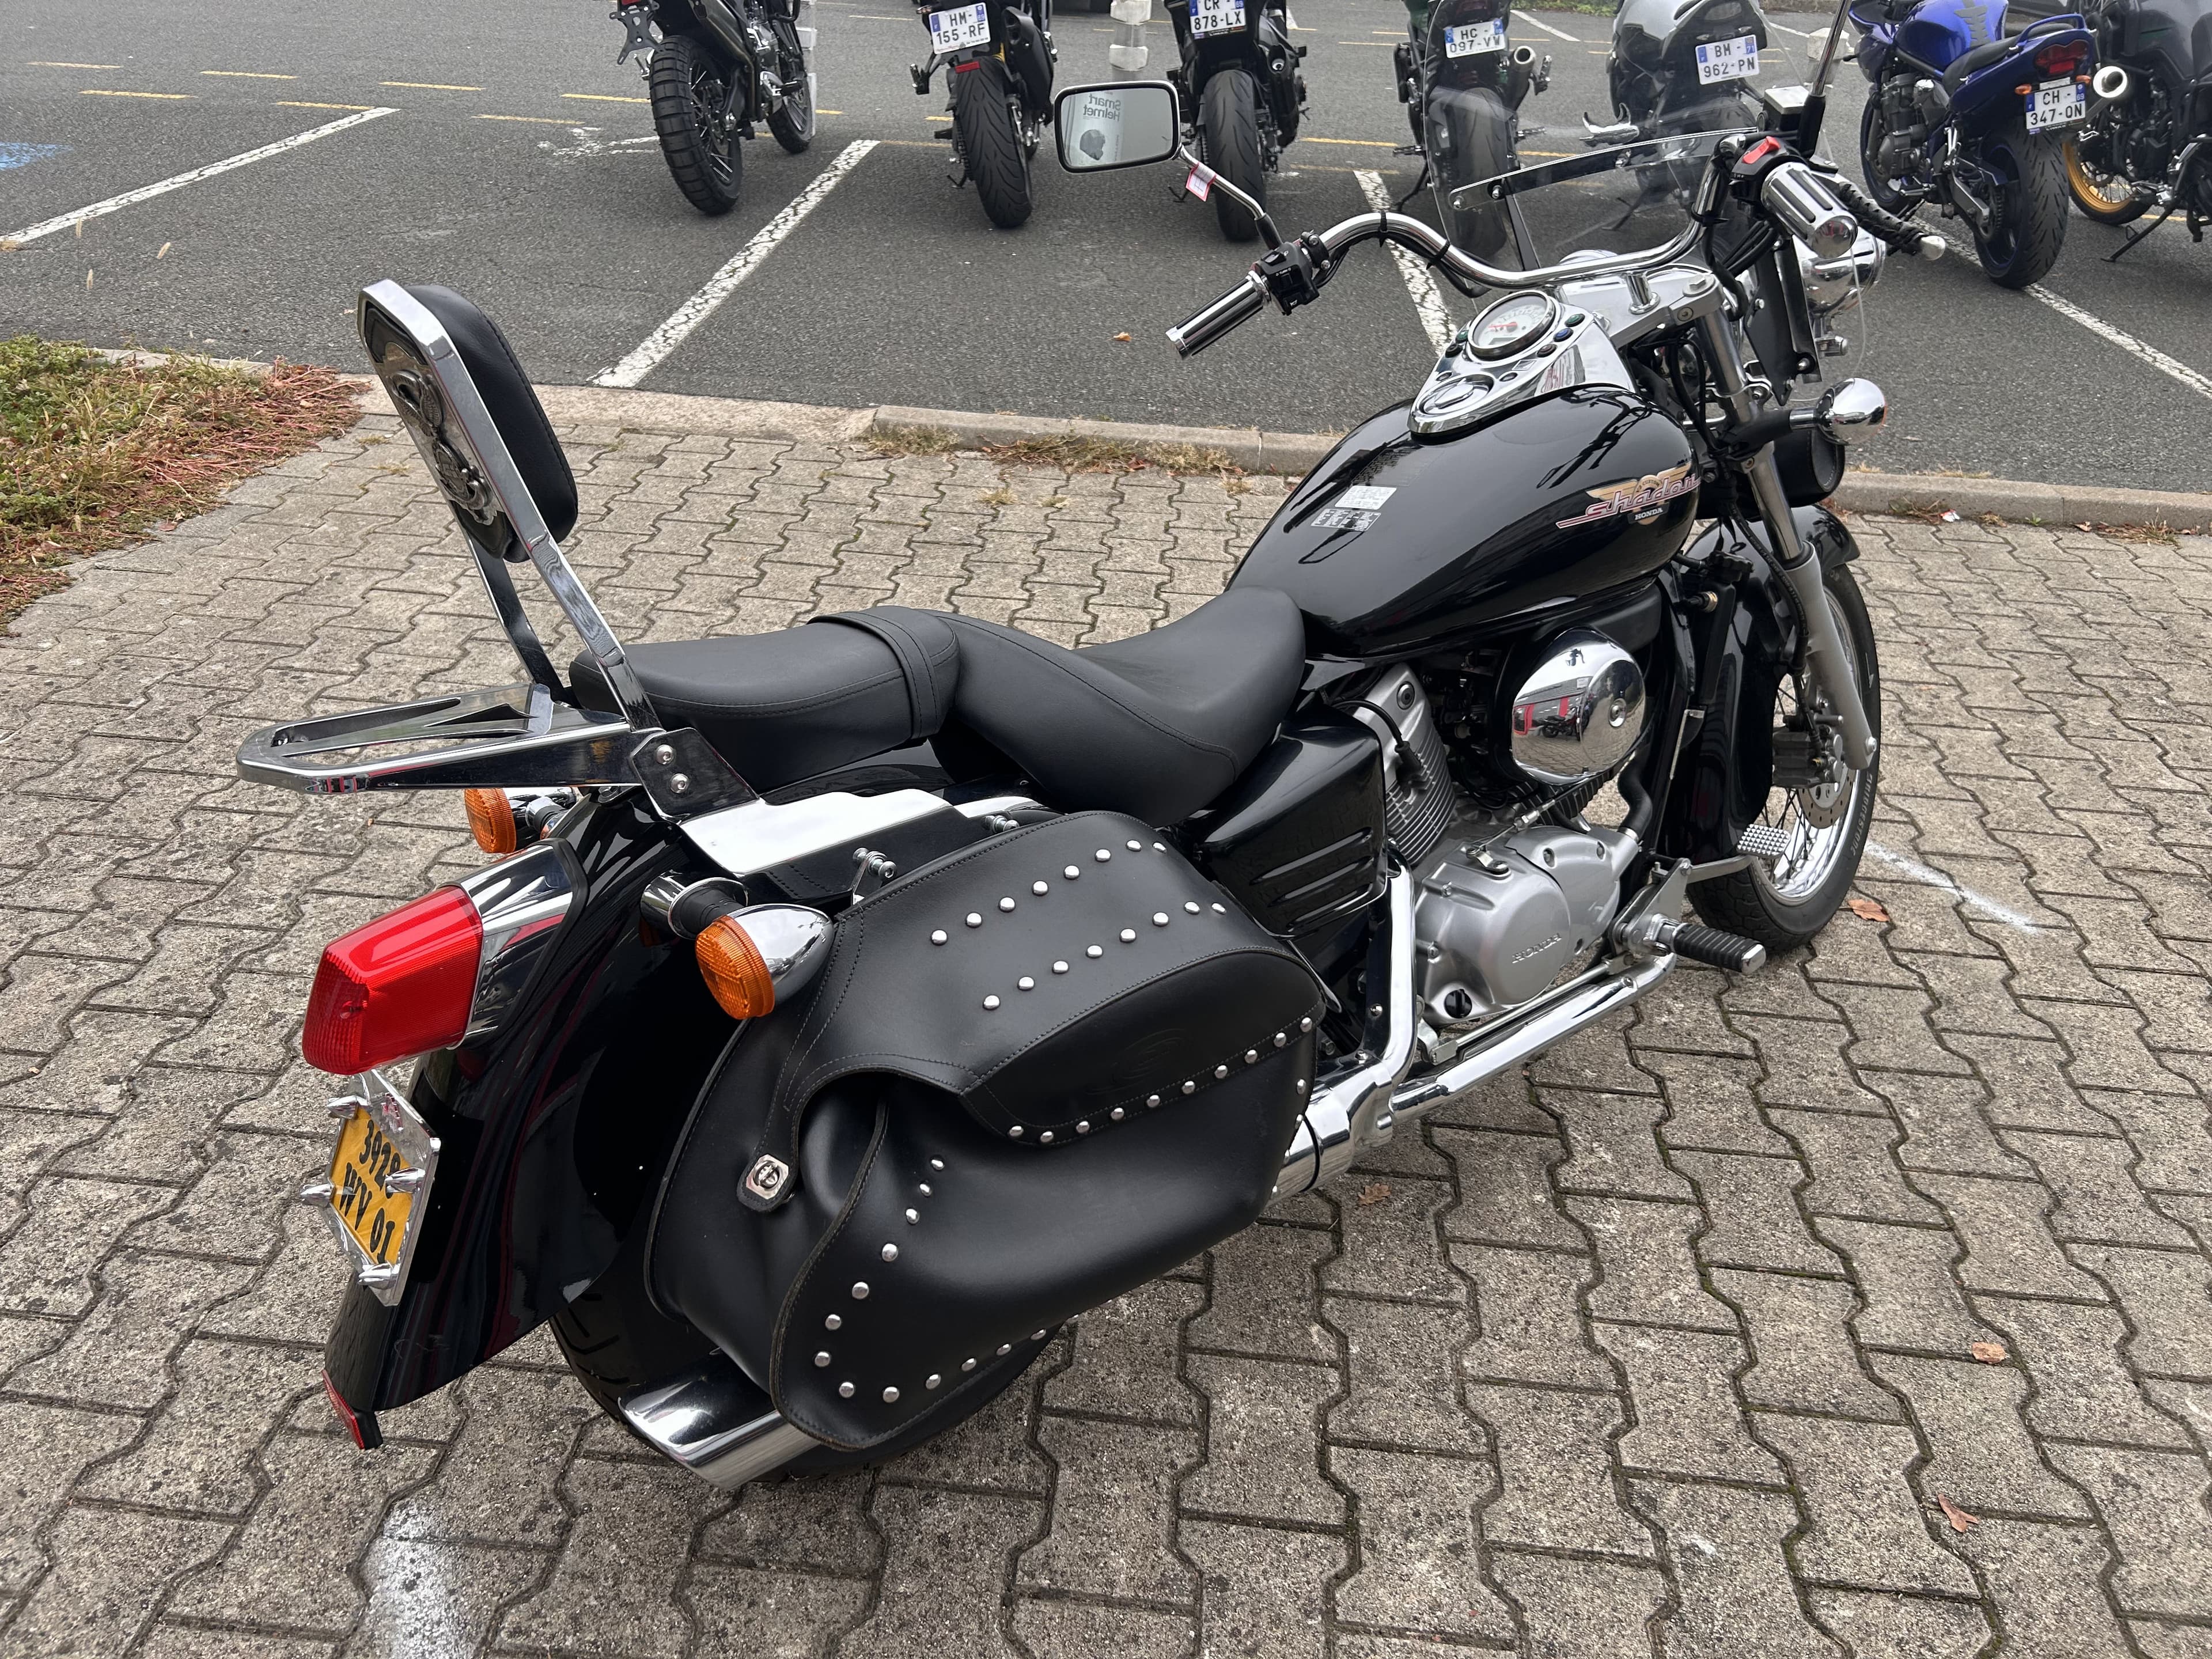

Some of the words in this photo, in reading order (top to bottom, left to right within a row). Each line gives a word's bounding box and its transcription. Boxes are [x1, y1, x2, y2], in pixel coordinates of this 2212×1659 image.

[1194, 11, 1241, 30] 878-LX
[937, 23, 985, 44] 155-RF
[1703, 57, 1755, 78] 962-PN
[1634, 507, 1664, 521] HONDA
[1512, 933, 1562, 964] HONDA
